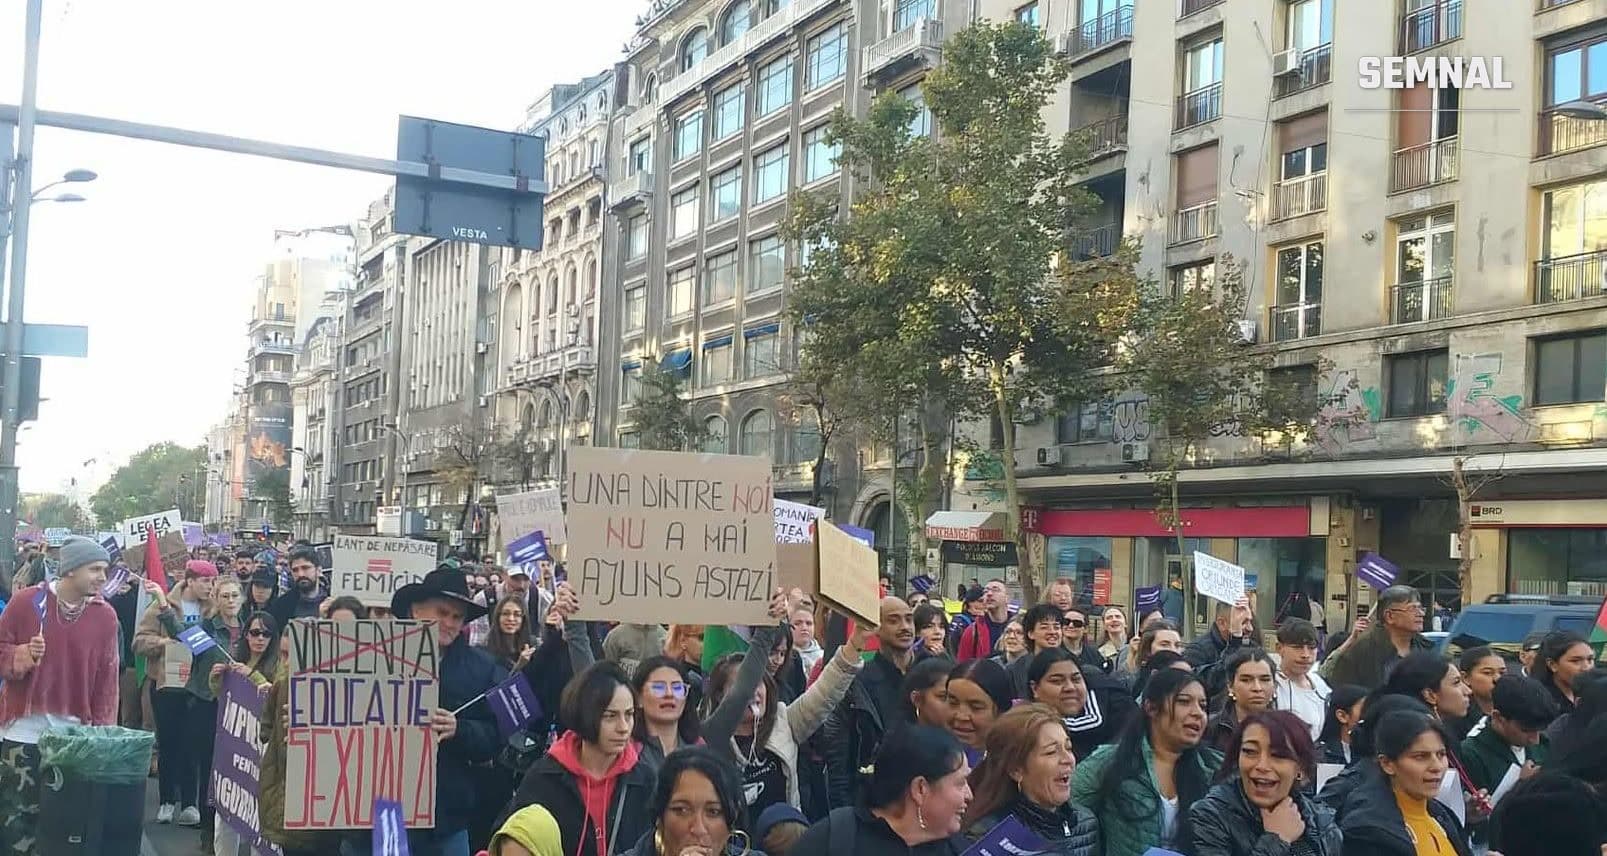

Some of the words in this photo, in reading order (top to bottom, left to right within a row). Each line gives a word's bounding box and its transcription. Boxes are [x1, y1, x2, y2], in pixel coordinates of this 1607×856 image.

[452, 226, 487, 239] VESTA
[572, 472, 630, 505] UNA
[642, 473, 726, 511] DINTRE
[732, 476, 771, 514] NOI
[1481, 507, 1503, 515] BRD
[367, 541, 379, 551] DE
[606, 517, 645, 549] NU
[665, 521, 685, 551] A
[704, 518, 747, 553] MAI
[581, 557, 682, 605] AJUNS
[693, 561, 773, 602] ASTAZI
